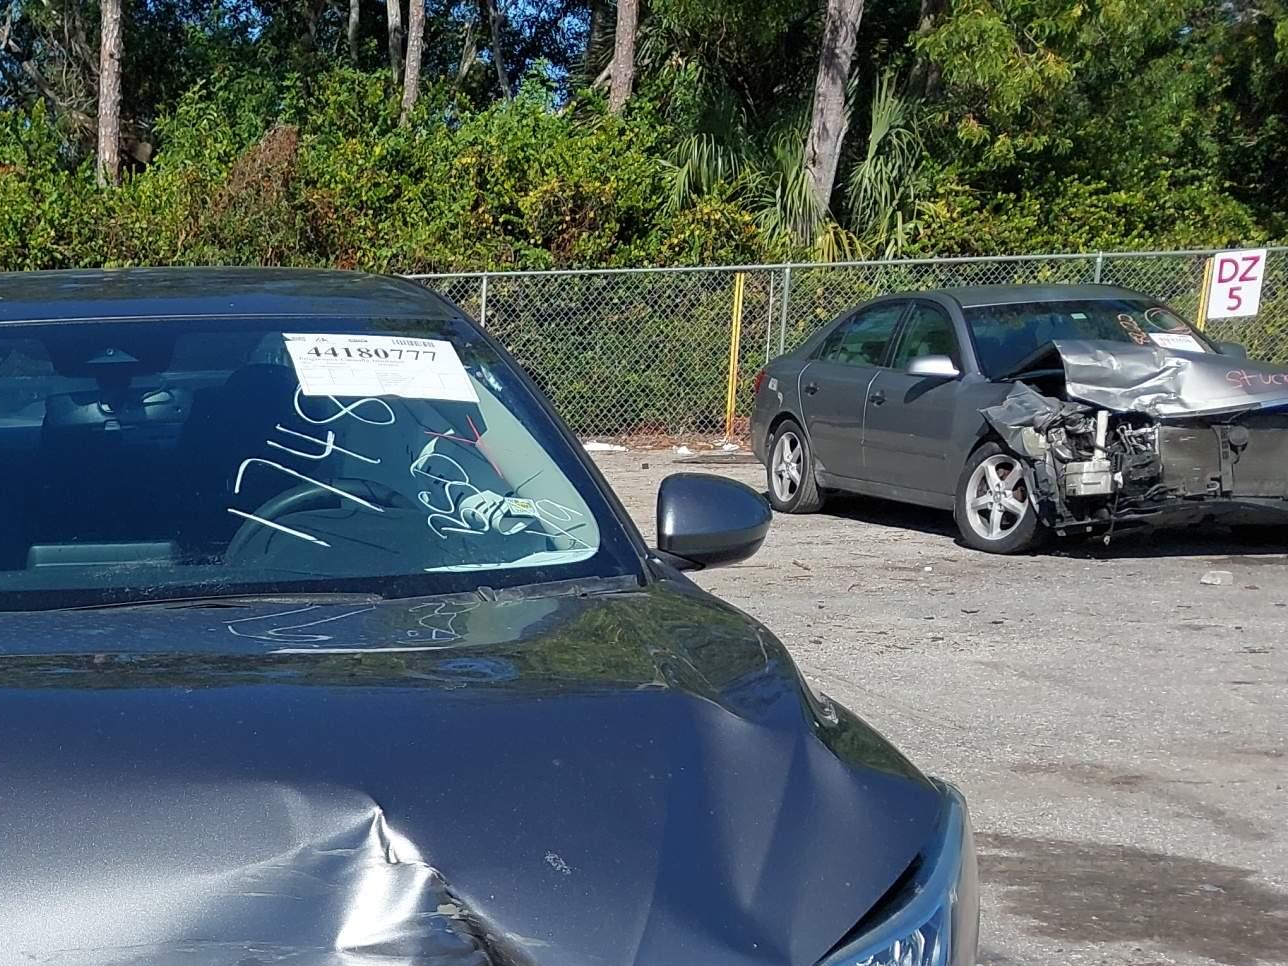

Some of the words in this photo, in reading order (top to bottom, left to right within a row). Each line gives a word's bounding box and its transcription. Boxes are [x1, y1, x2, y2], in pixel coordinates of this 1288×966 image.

[1217, 255, 1261, 283] DZ
[1226, 286, 1242, 311] 5
[307, 346, 436, 361] 44180777
